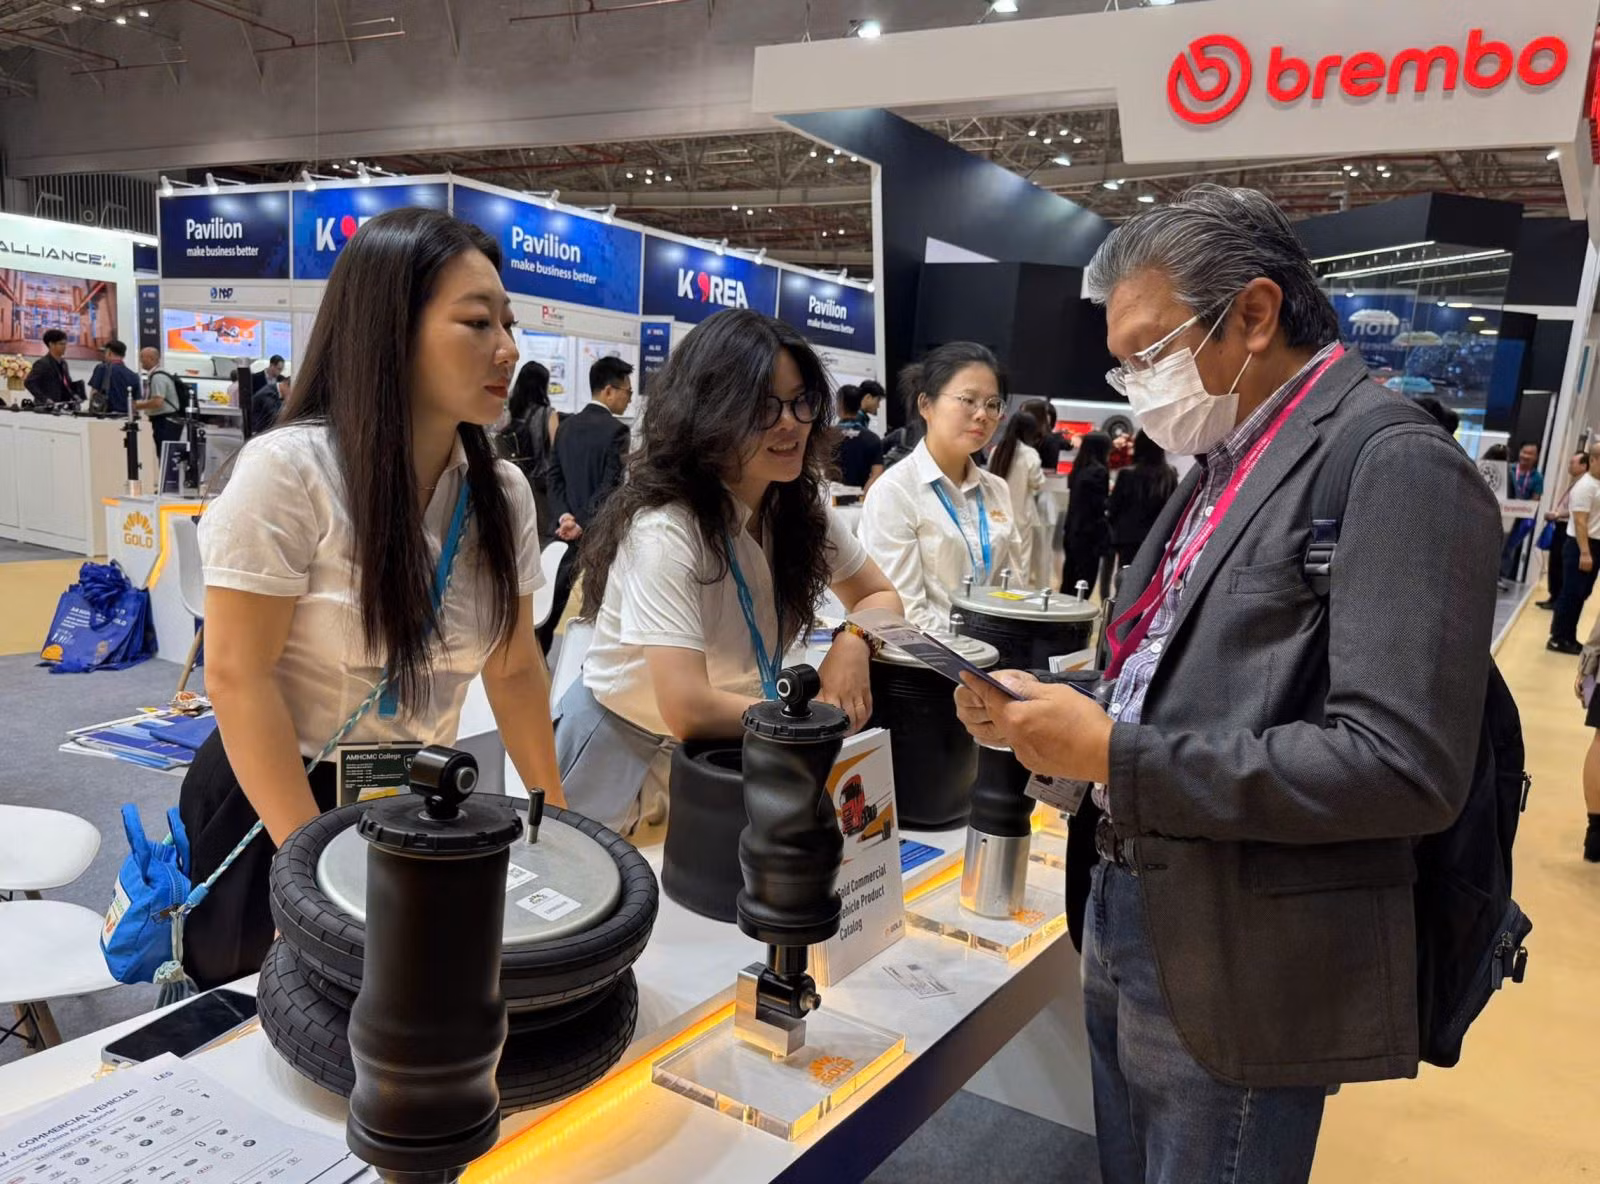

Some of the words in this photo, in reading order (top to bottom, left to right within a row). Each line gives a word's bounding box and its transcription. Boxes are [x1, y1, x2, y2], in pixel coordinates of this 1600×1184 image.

[1266, 29, 1569, 103] brembo
[186, 217, 243, 240] Pavilion
[186, 246, 205, 256] make
[205, 245, 235, 256] business
[236, 245, 259, 256] better
[512, 225, 581, 263] Pavilion
[511, 258, 535, 272] make
[536, 261, 572, 279] business
[573, 269, 597, 285] better
[677, 268, 749, 309] KOREA
[808, 295, 847, 320] Pavilion
[124, 533, 153, 548] GOLD
[851, 863, 886, 892] Commercial
[840, 898, 860, 919] ehicle
[861, 884, 885, 907] Product
[840, 918, 863, 941] Catalog
[17, 1113, 91, 1149] COMMERCIAL
[88, 1088, 139, 1114] VEHICLES
